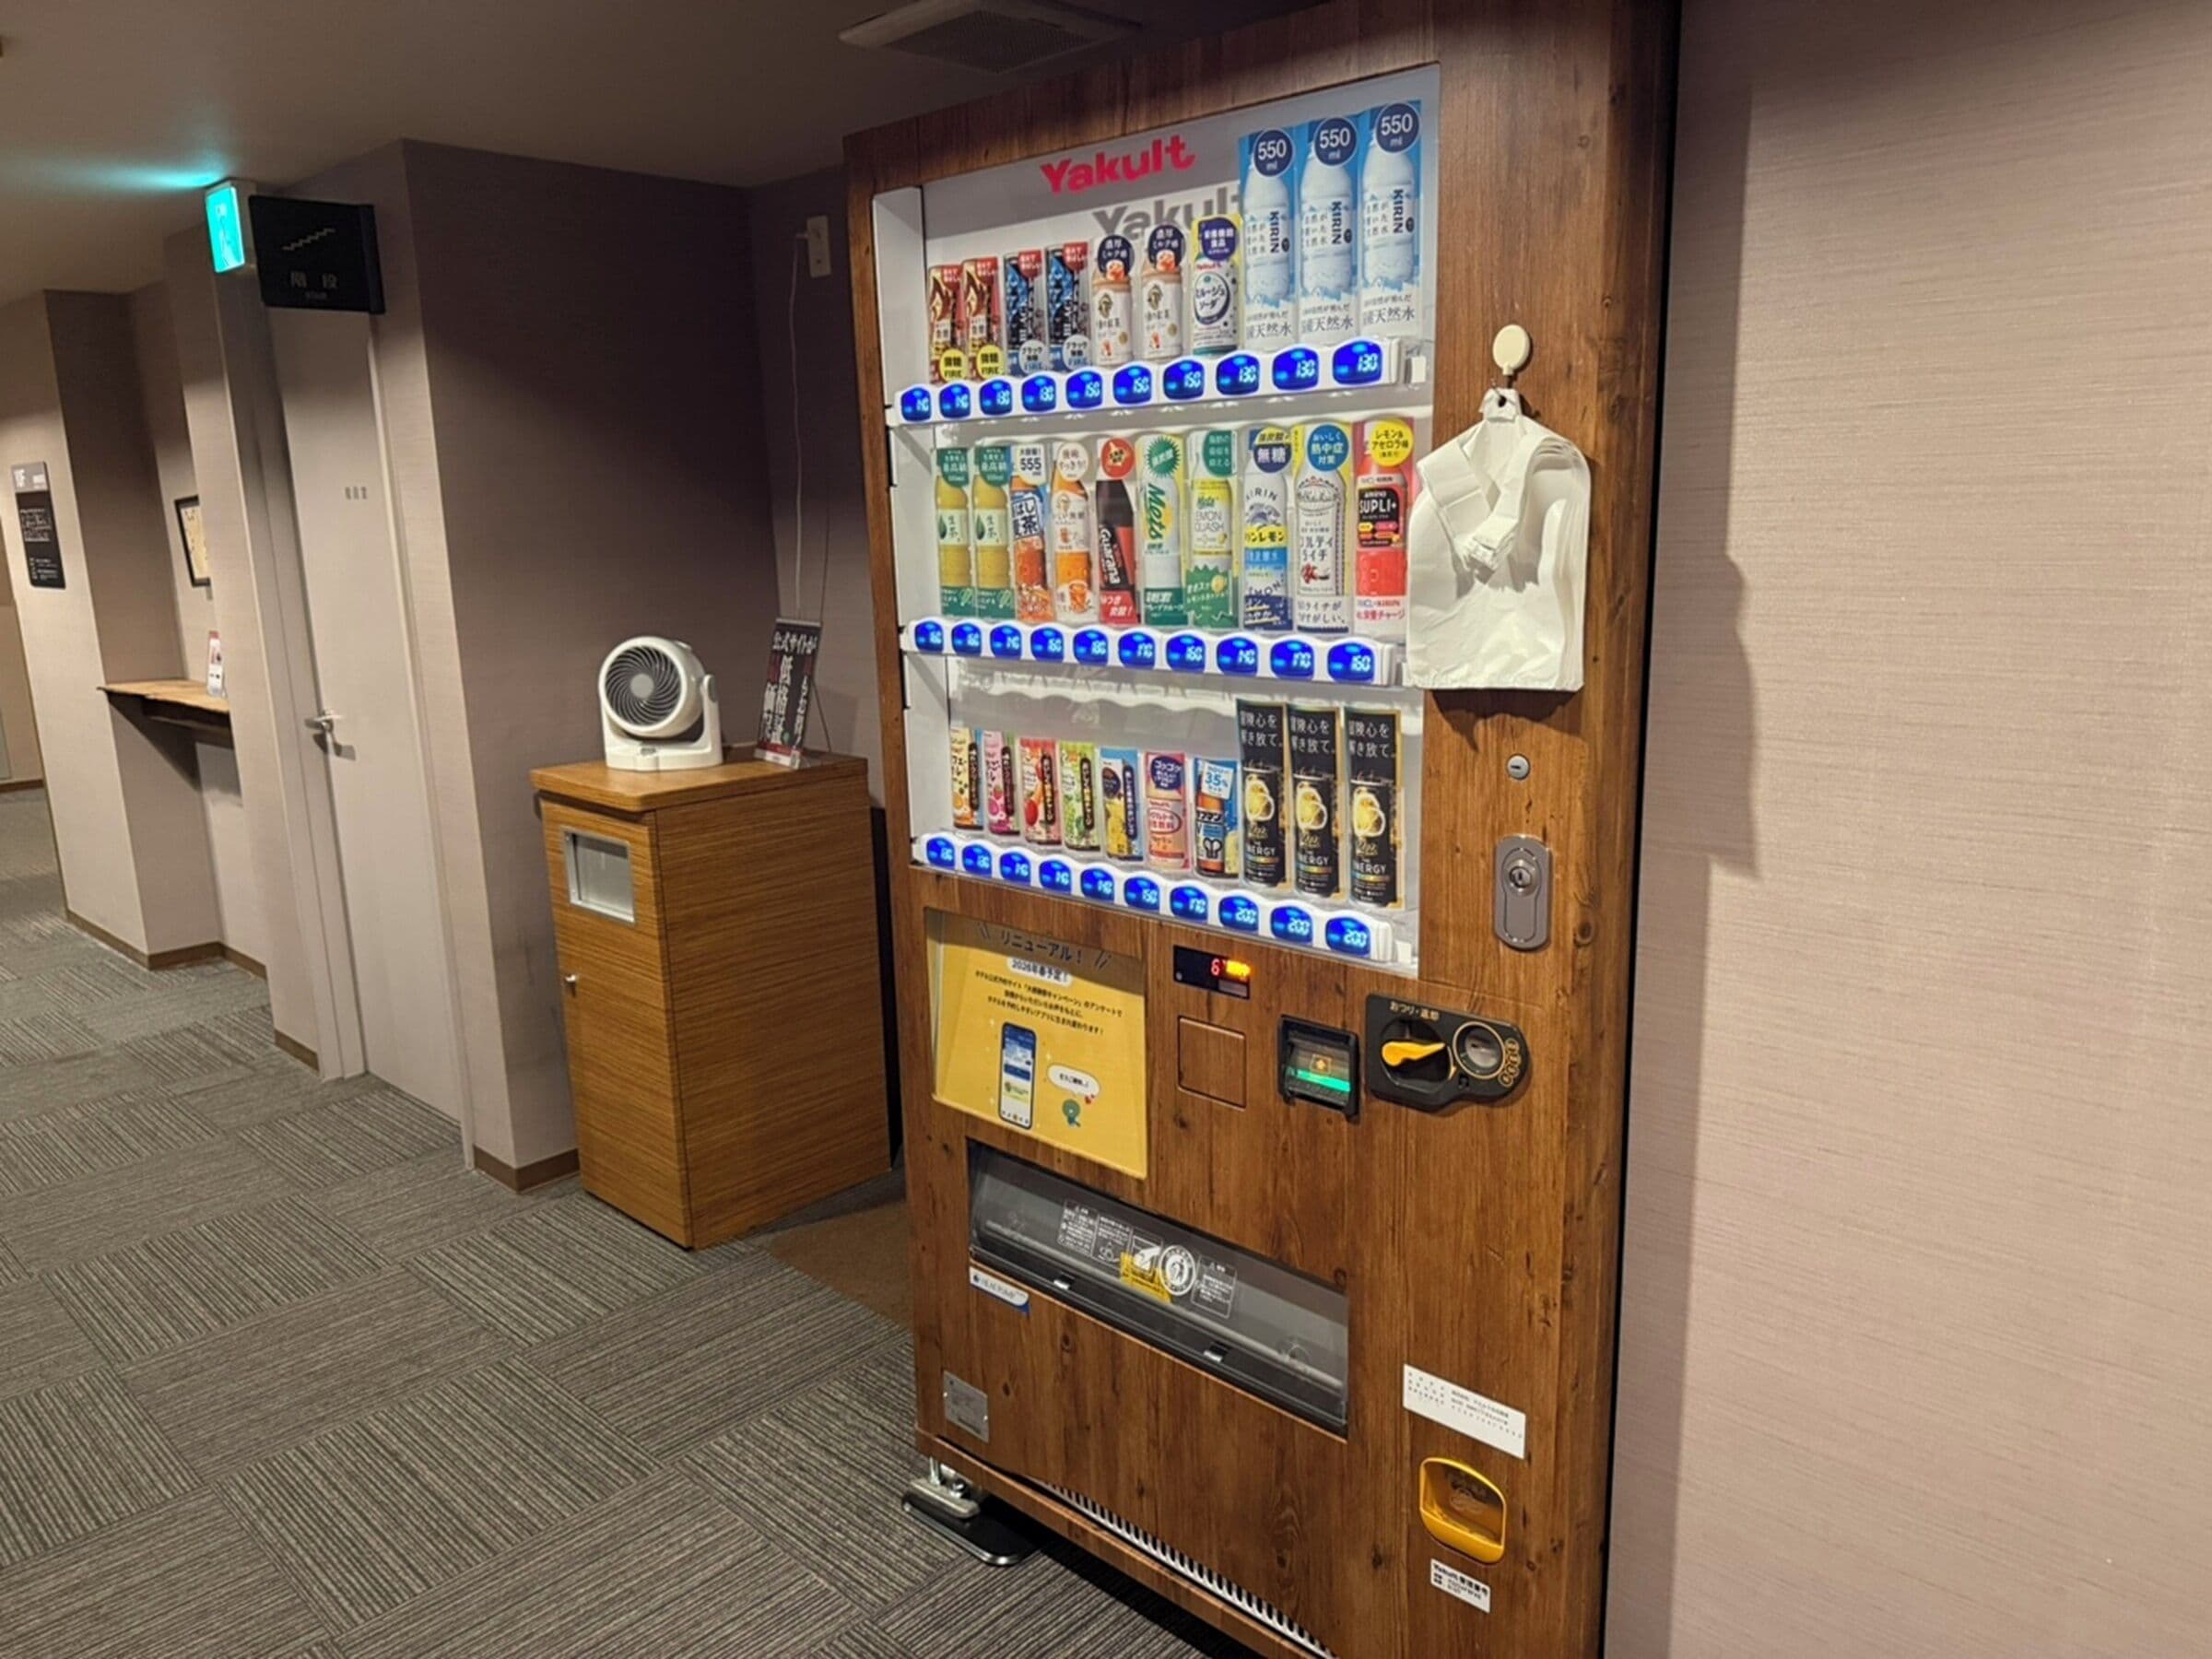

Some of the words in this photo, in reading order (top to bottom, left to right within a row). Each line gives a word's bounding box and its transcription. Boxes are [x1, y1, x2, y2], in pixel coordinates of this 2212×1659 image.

[1381, 112, 1413, 135] 550
[1319, 127, 1350, 149] 550
[1257, 139, 1287, 161] 550
[1041, 135, 1195, 194] Yakult
[1393, 189, 1404, 234] KIRIN
[1331, 201, 1343, 245] KIRIN
[1269, 211, 1279, 254] KIRIN
[1296, 359, 1315, 378] 130
[1358, 353, 1378, 372] 130
[1184, 371, 1201, 388] 150
[1239, 365, 1256, 382] 130
[1086, 382, 1100, 398] 150
[1134, 377, 1149, 394] 150
[1312, 433, 1341, 441] おいしく
[1372, 440, 1408, 451] アセロラ味
[1257, 448, 1287, 464] 無糖
[1311, 442, 1344, 454] 熱中症
[1020, 457, 1041, 471] 555
[1318, 455, 1335, 465] 対策
[1147, 483, 1165, 544] Mets
[1100, 526, 1121, 585] Guarana
[1137, 643, 1153, 658] 170
[1238, 650, 1255, 665] 140
[1292, 653, 1312, 668] 170
[1142, 888, 1158, 904] 150
[1189, 899, 1206, 913] 170
[1236, 907, 1257, 924] 200
[1288, 917, 1311, 935] 200
[1345, 929, 1367, 947] 200
